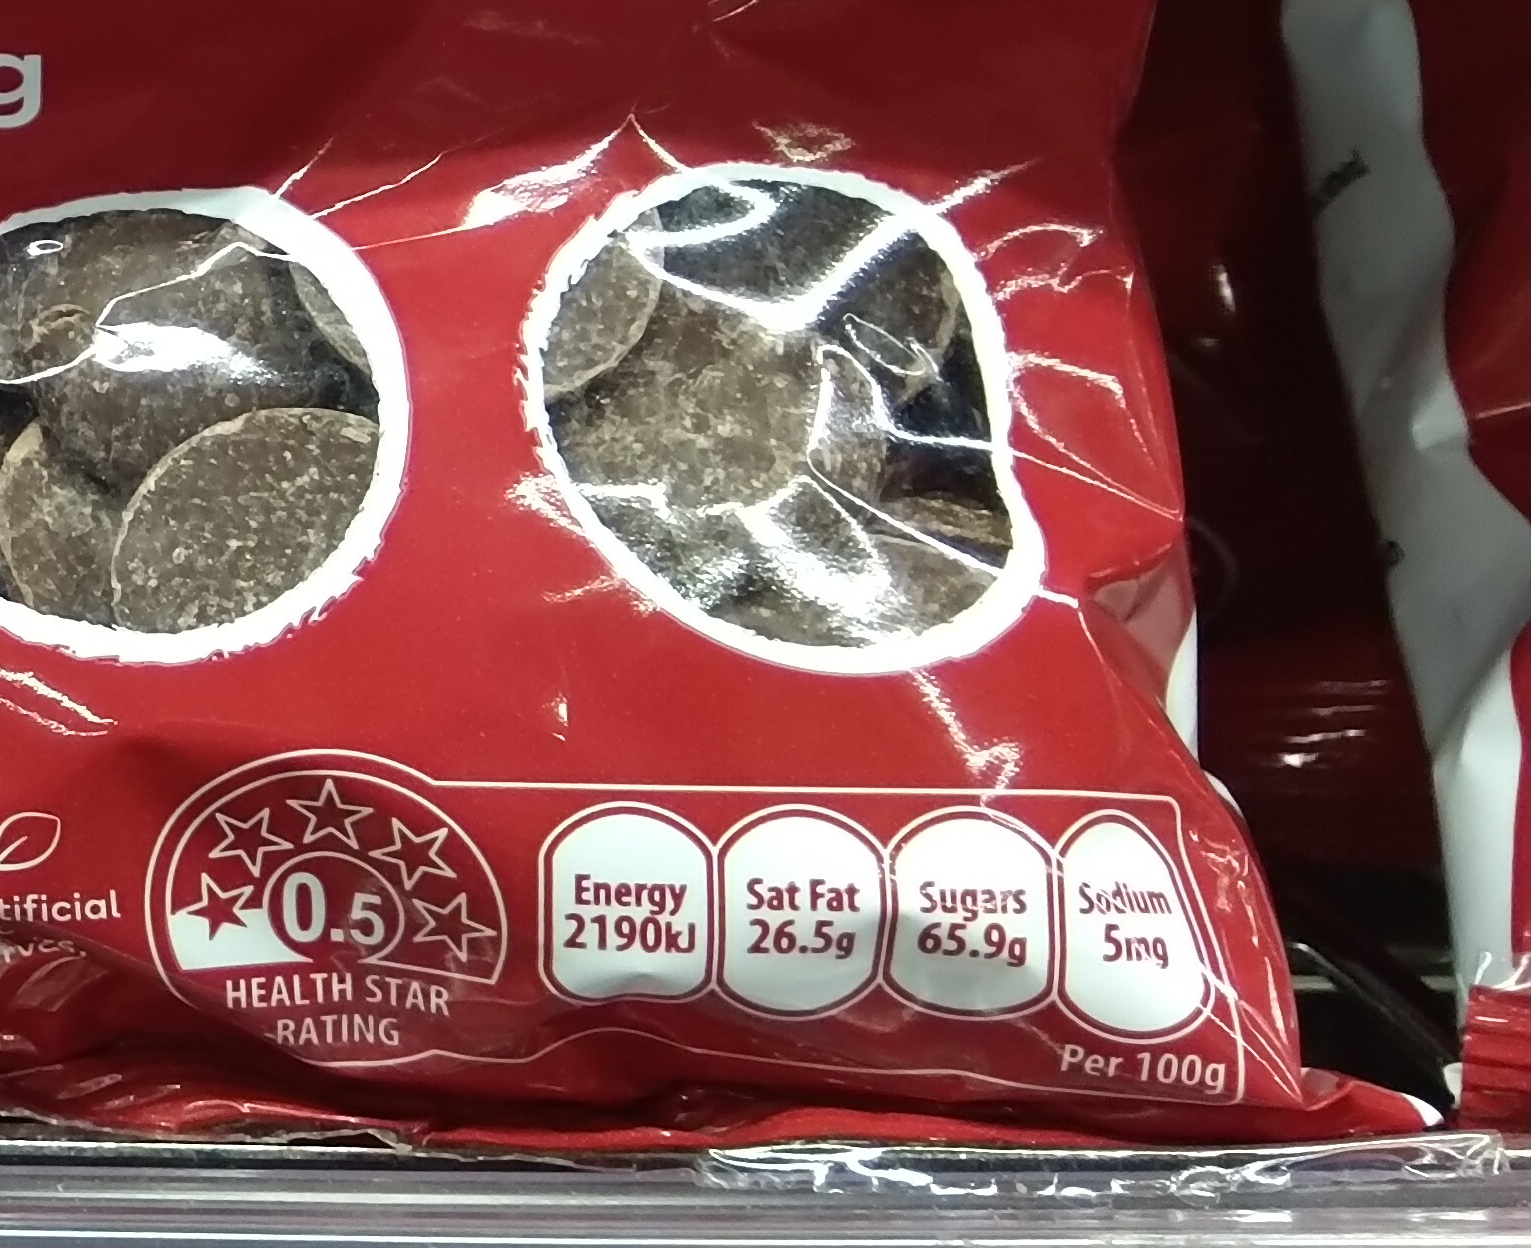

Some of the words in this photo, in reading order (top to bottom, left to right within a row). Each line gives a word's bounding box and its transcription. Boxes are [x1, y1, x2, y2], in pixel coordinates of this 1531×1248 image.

[282, 872, 386, 946] 0.5
[573, 873, 688, 916] Energy
[746, 877, 801, 912] Sat
[809, 878, 861, 913] Fat
[918, 880, 1028, 922] Sugars
[1078, 881, 1173, 915] Sodium
[562, 912, 696, 954] 2190kJ
[746, 918, 857, 960] 26.5g
[917, 922, 1028, 968] 65.9g
[1102, 923, 1170, 970] 5mg
[225, 972, 354, 1009] HEALTH
[365, 973, 451, 1017] STAR
[275, 1012, 400, 1046] RATING
[1060, 1043, 1125, 1077] Per
[1136, 1052, 1226, 1095] 100g
